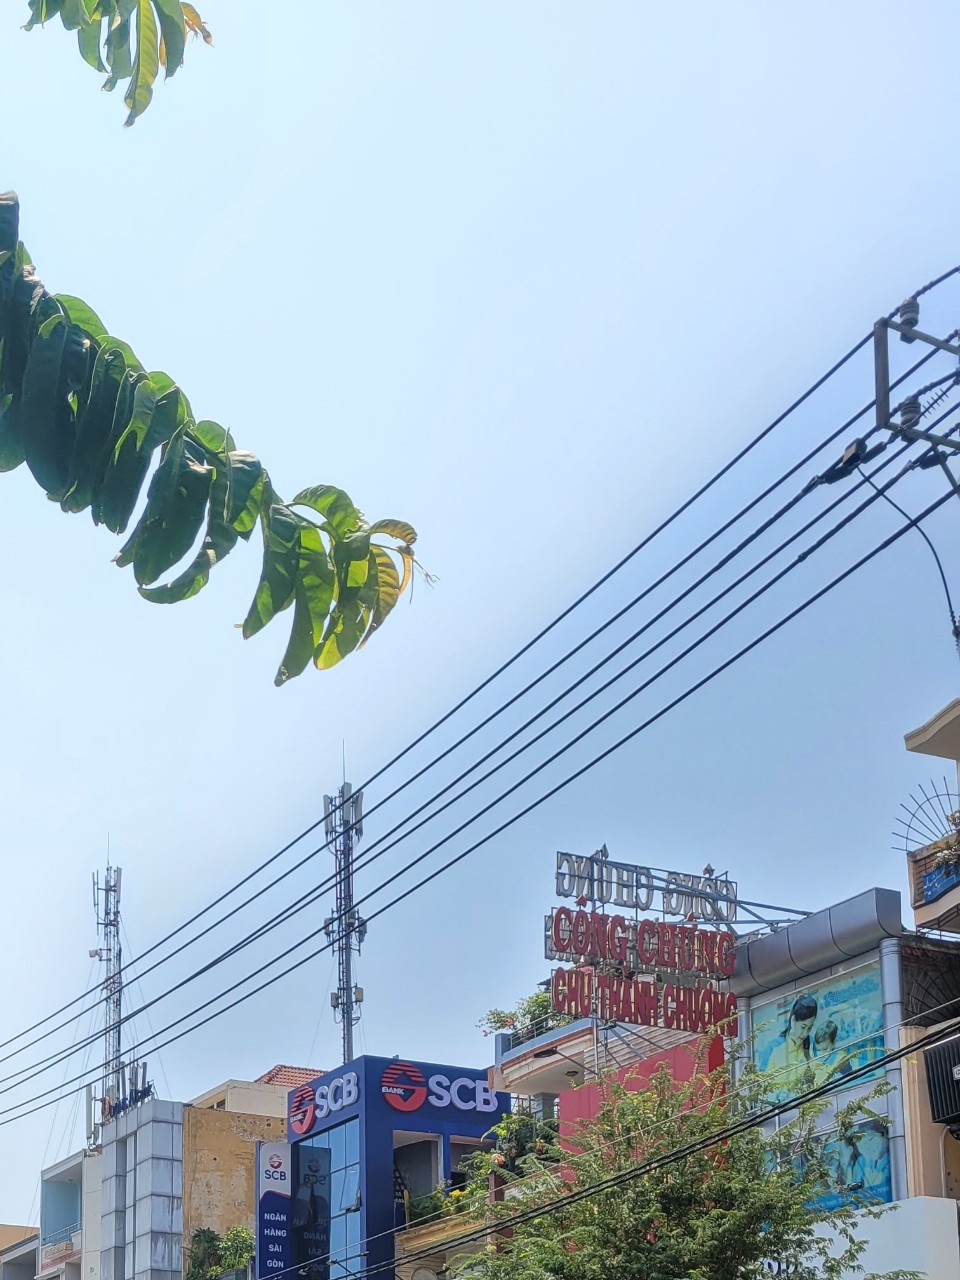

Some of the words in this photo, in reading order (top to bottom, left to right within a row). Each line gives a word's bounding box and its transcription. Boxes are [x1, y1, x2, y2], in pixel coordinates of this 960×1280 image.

[552, 894, 629, 961] CÔNG
[638, 912, 737, 977] CHỨNG
[315, 1071, 359, 1118] SCB
[427, 1074, 499, 1113] SCB
[264, 1169, 287, 1181] SCB
[264, 1210, 287, 1222] NGÂN
[264, 1226, 287, 1238] HÀNG
[268, 1242, 282, 1253] SÀI
[266, 1257, 284, 1269] GÒN
